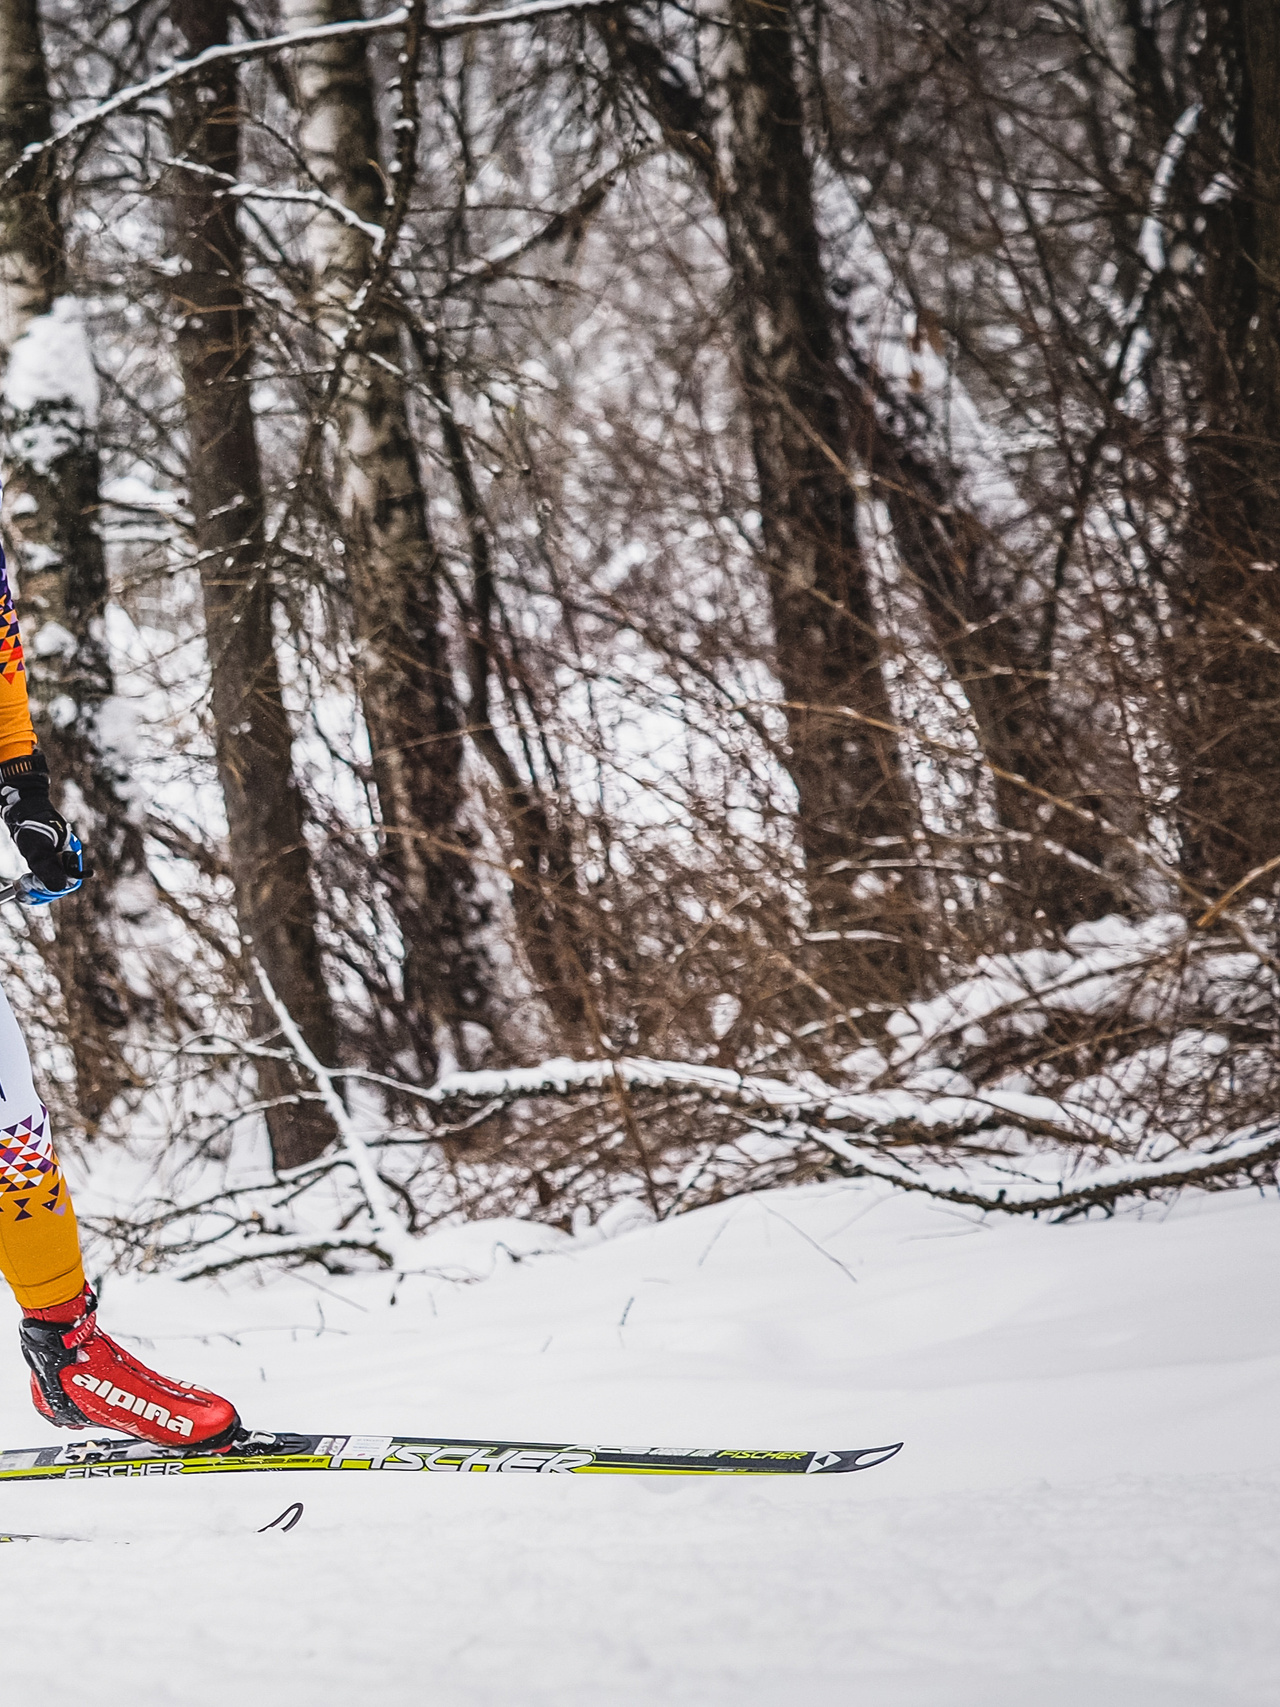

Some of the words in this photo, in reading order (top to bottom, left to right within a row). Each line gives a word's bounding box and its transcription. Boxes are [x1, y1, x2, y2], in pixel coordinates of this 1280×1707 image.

[71, 1373, 194, 1437] alpina
[717, 1450, 808, 1461] FISCHER
[64, 1462, 184, 1479] FISCHER
